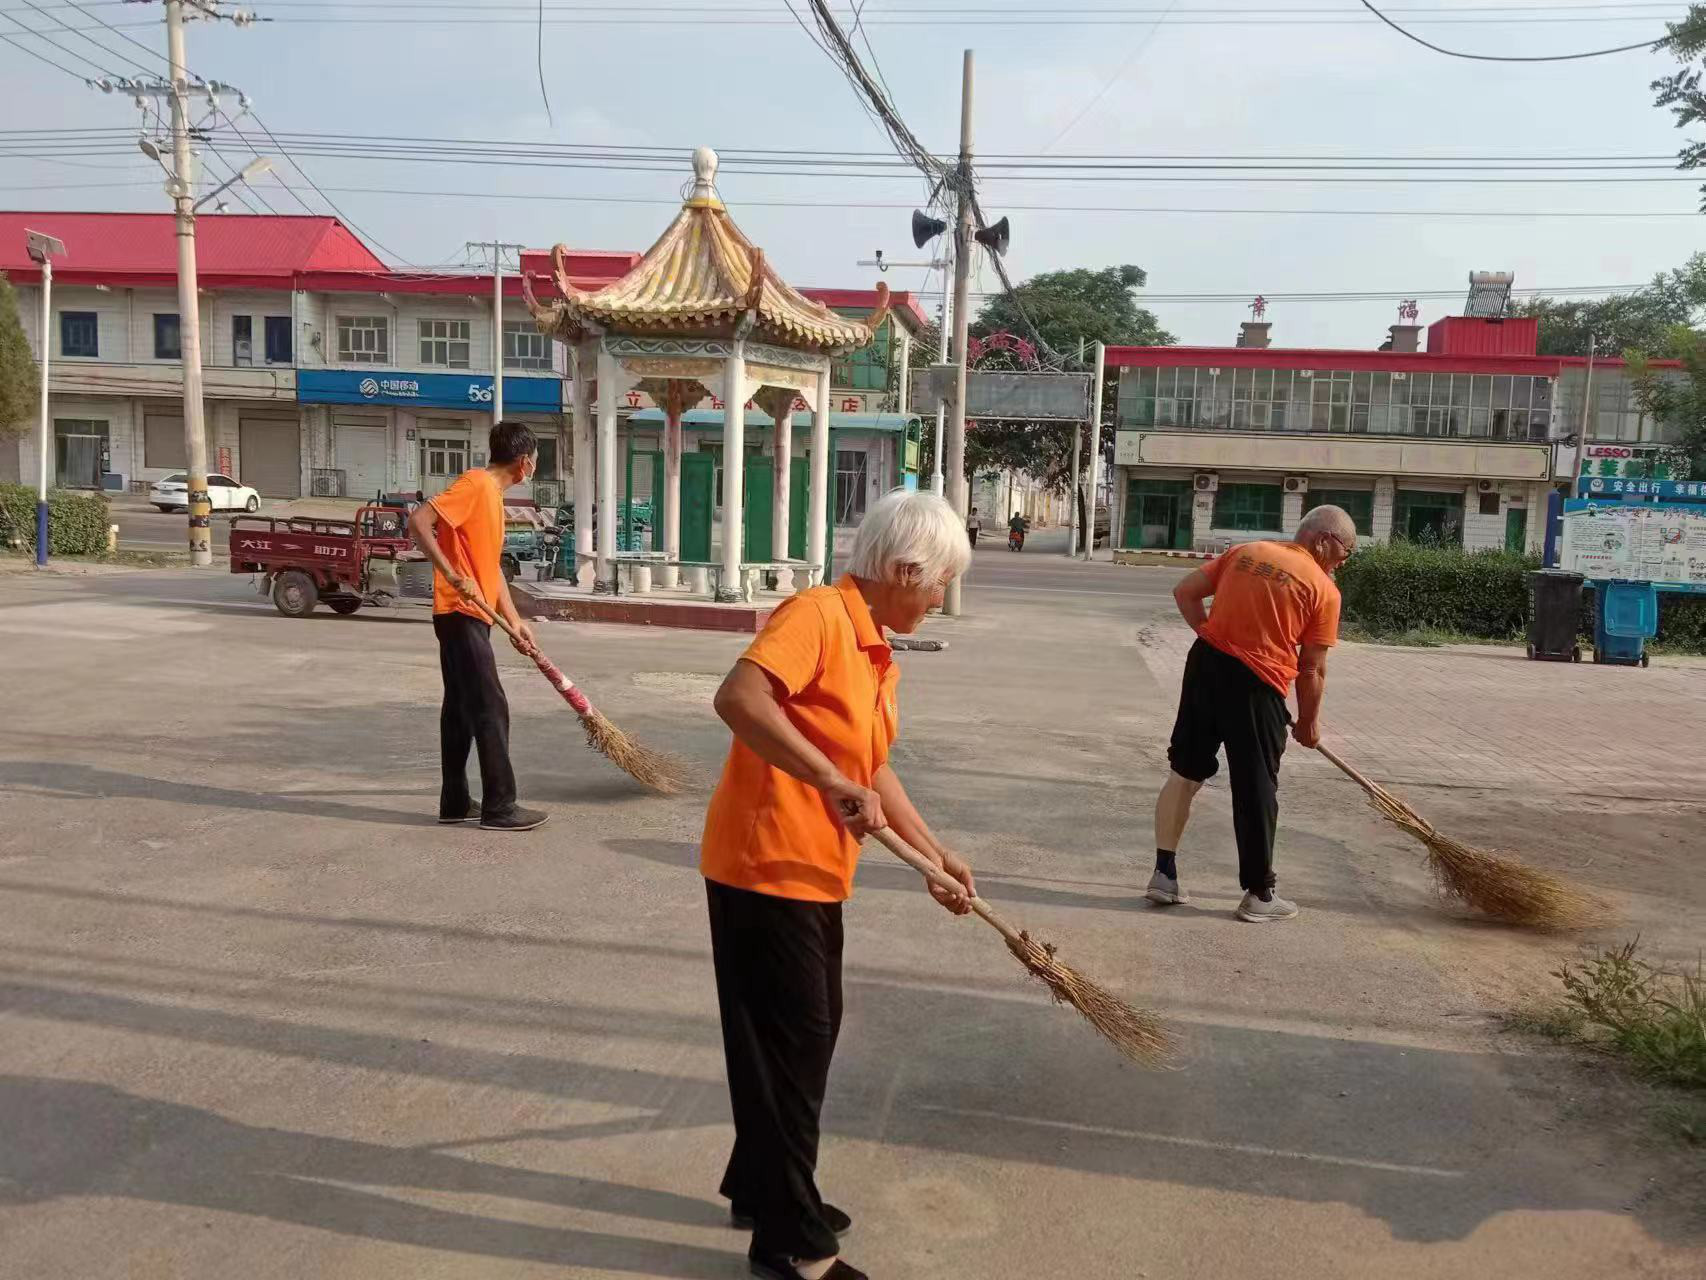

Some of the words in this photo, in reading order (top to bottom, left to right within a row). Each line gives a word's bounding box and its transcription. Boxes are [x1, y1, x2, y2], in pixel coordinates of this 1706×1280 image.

[1397, 299, 1419, 319] 福
[380, 380, 419, 391] 中国移动
[1587, 447, 1631, 459] LESSO
[1613, 481, 1662, 494] 安全出行
[240, 539, 272, 550] 大江
[313, 545, 347, 557] 助力
